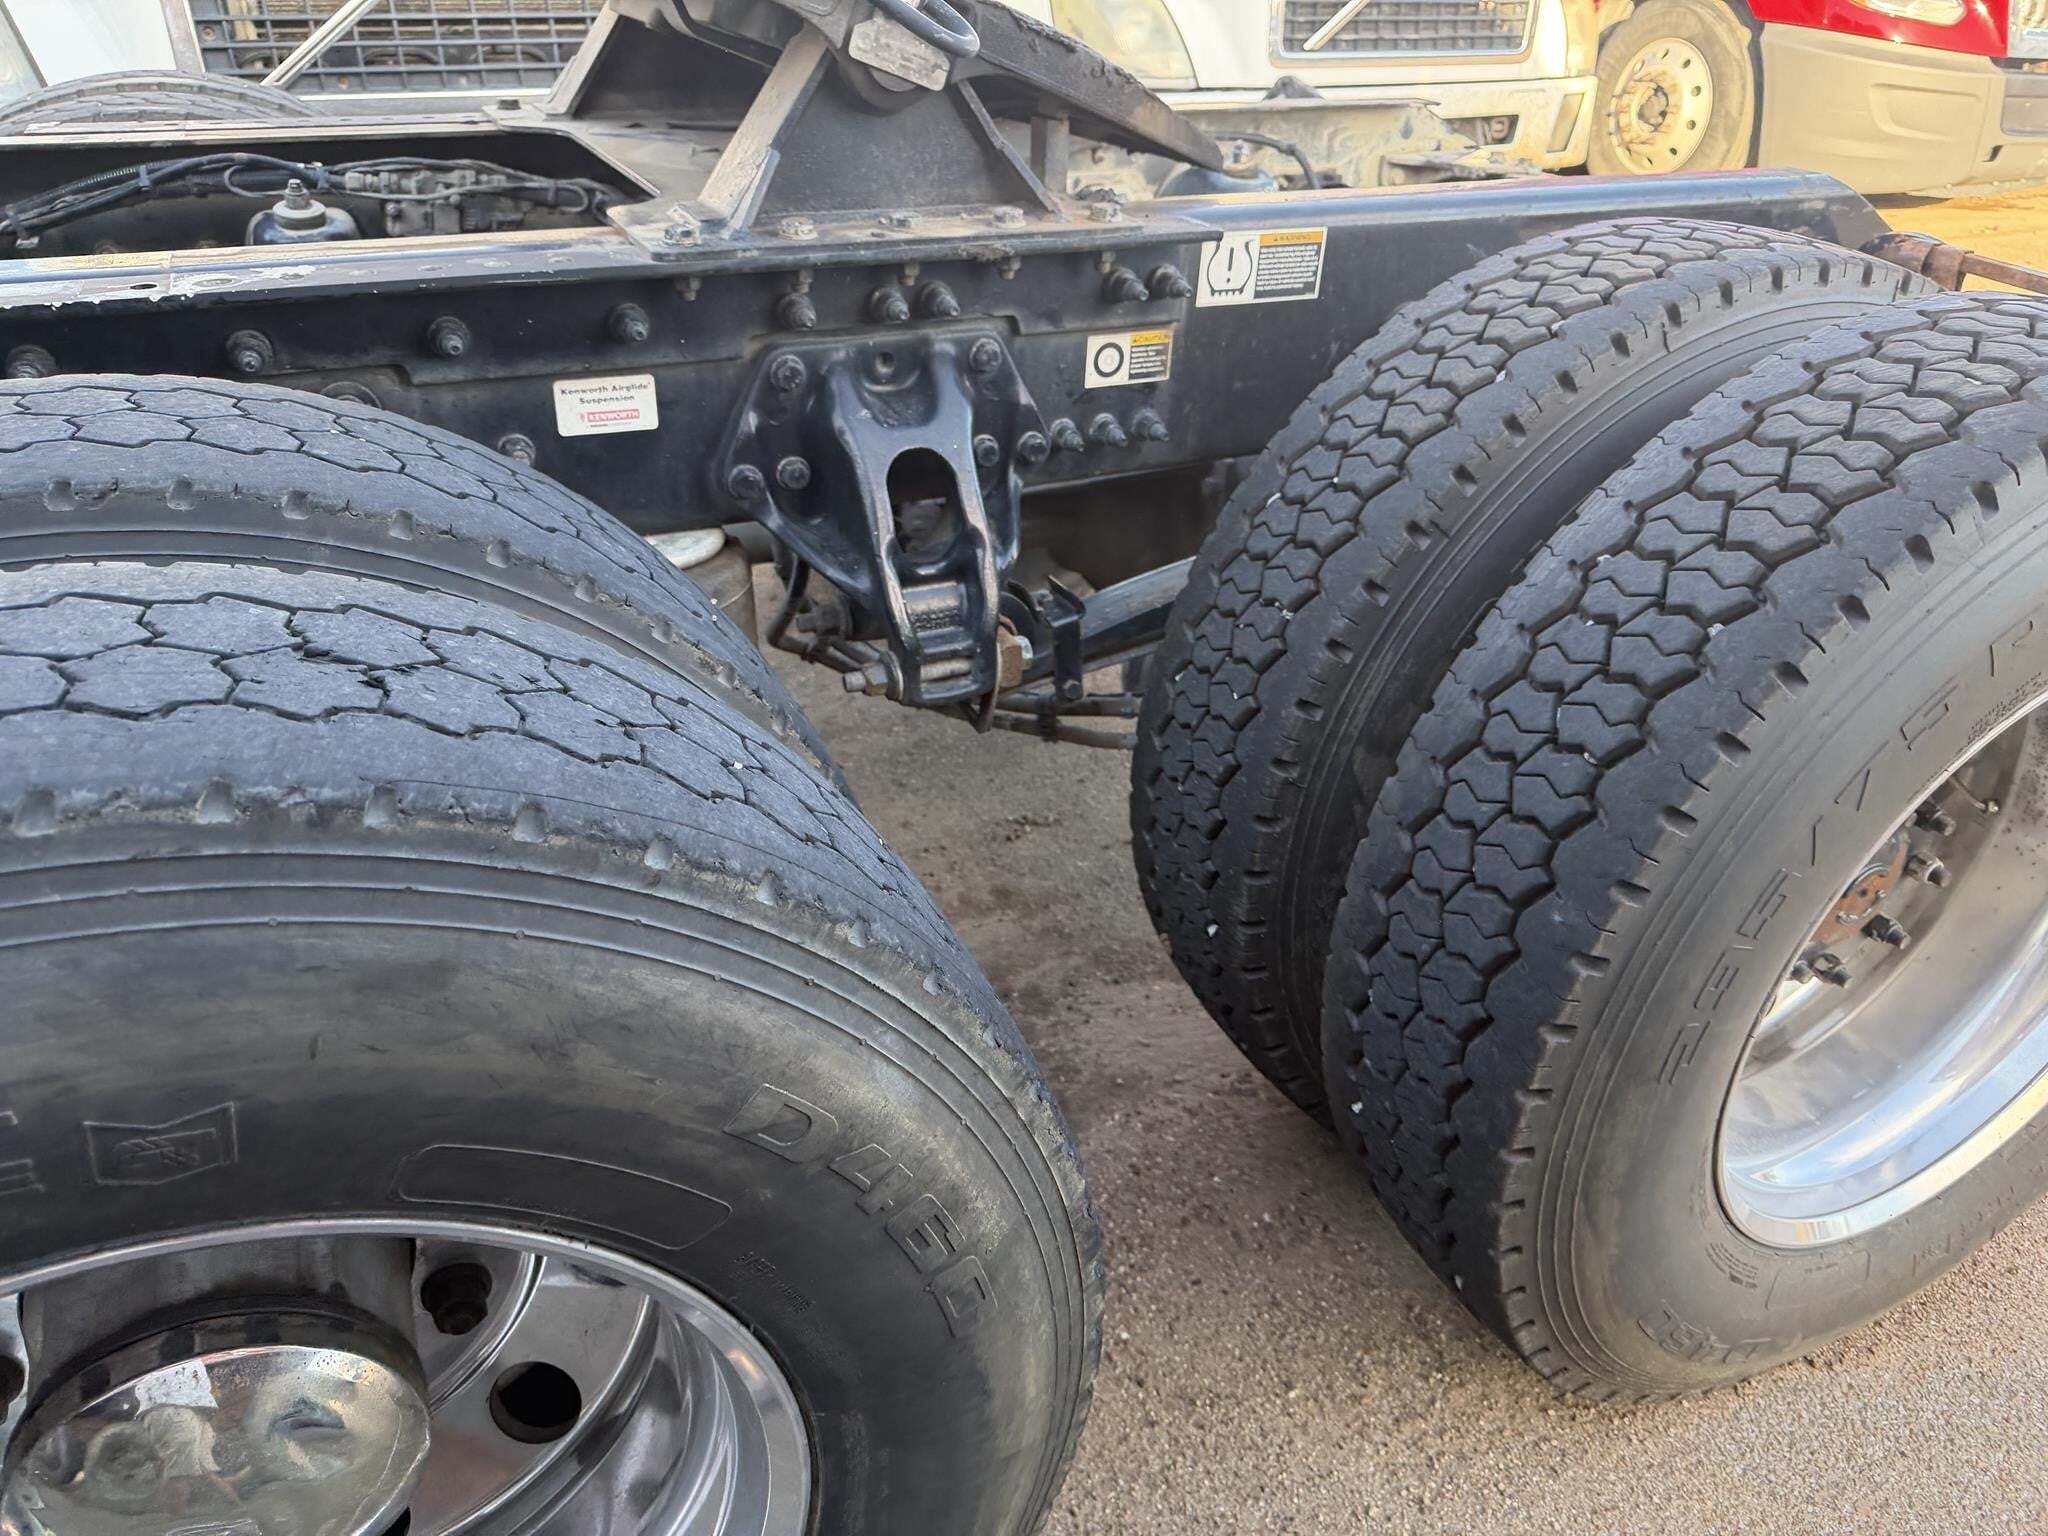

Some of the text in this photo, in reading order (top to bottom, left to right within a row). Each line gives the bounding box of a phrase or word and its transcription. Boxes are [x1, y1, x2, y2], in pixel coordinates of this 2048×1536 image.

[561, 382, 648, 396] Kenworth Airglide
[579, 395, 635, 405] Suspension
